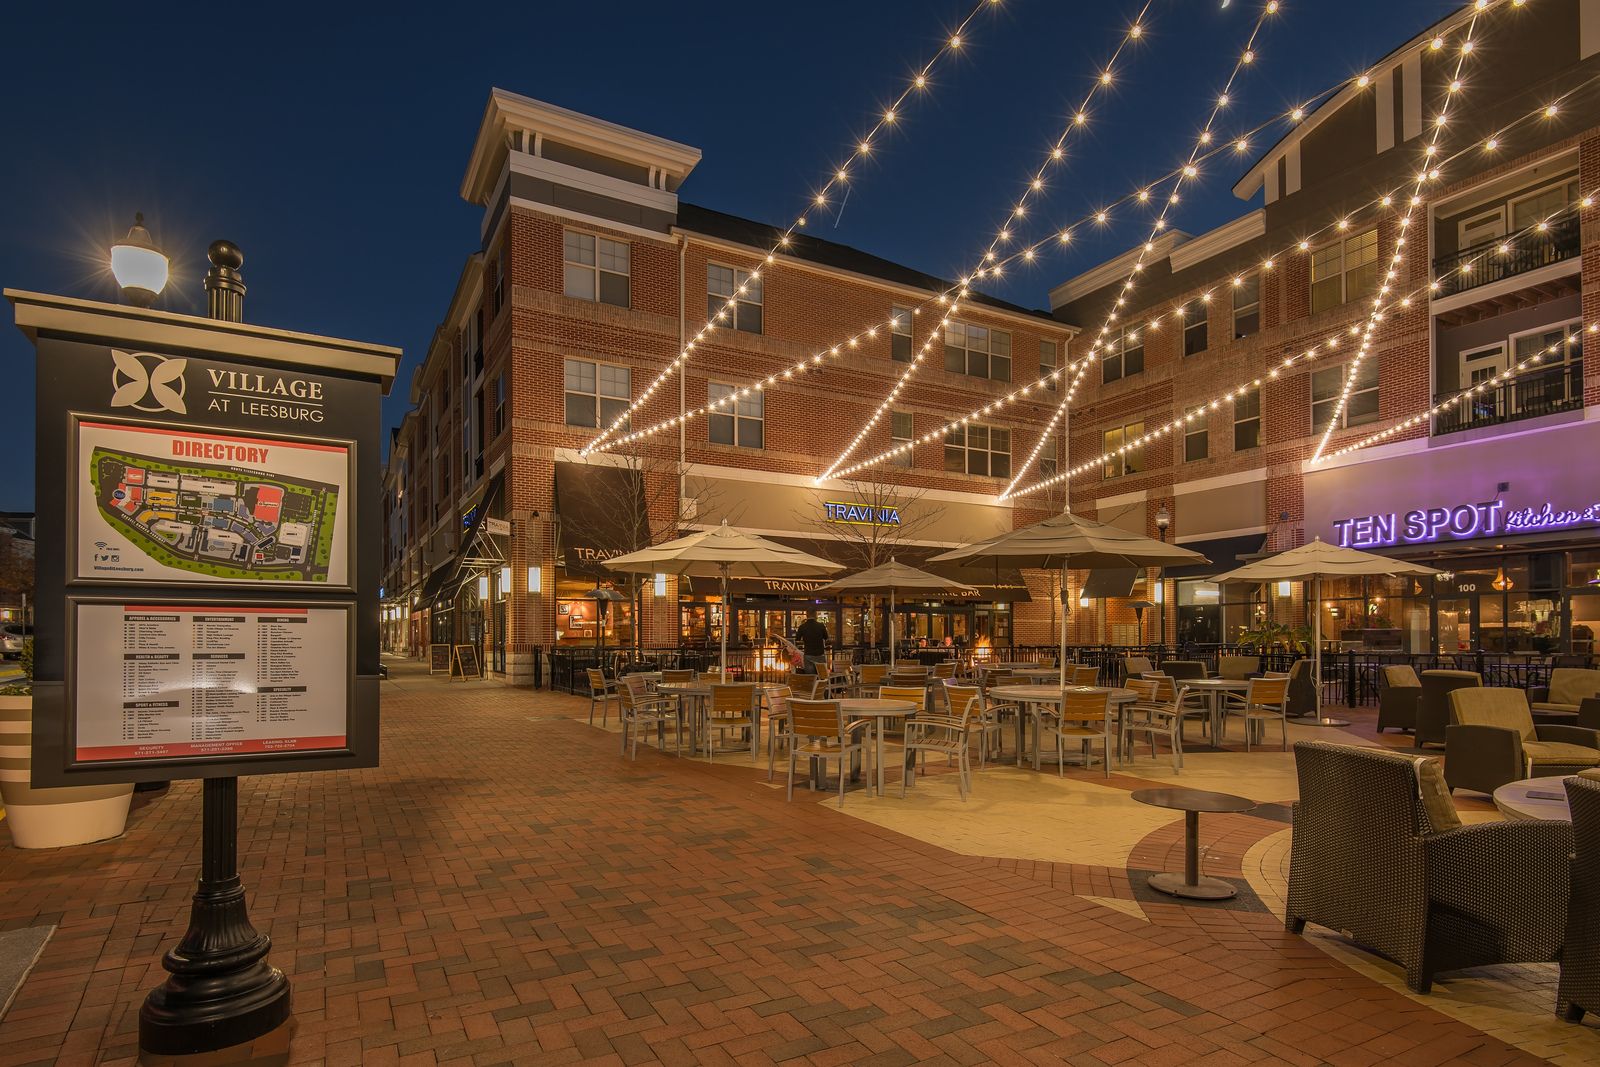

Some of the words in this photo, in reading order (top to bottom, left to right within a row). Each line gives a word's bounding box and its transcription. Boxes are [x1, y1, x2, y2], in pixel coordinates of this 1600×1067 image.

[207, 368, 324, 400] VILLAGE
[207, 398, 230, 412] AT
[241, 402, 325, 423] LEESBURG
[172, 439, 269, 464] DIRECTORY
[823, 501, 901, 524] TRAVINIA
[1333, 512, 1396, 547] TEN
[1402, 499, 1503, 541] SPOT
[1504, 502, 1583, 531] Kitchen
[1458, 583, 1476, 592] 100
